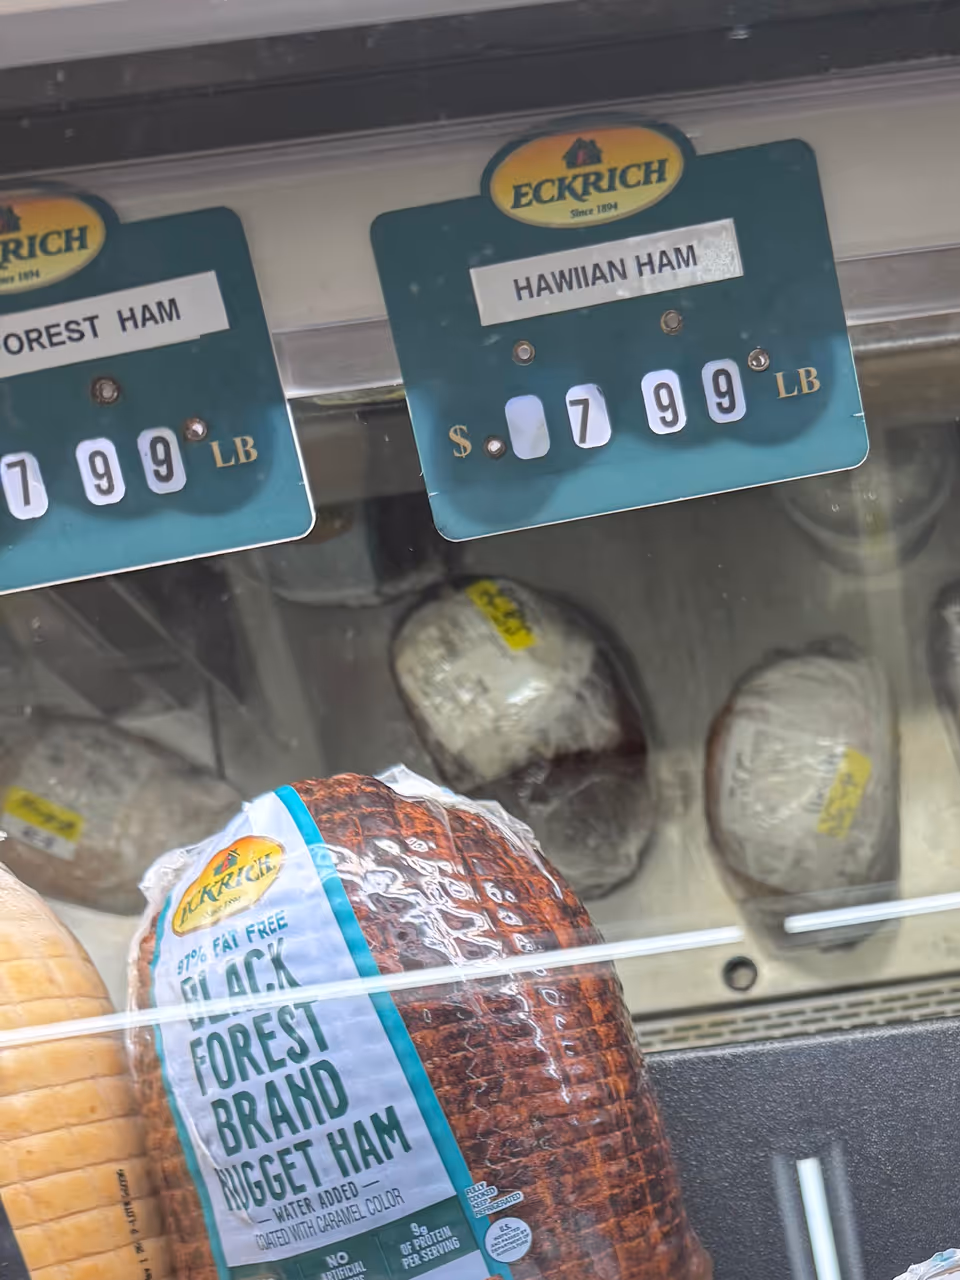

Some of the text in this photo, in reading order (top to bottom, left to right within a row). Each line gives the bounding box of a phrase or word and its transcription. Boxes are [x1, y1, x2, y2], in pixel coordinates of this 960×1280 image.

[510, 158, 668, 211] ECKRICH
[569, 201, 619, 219] Since 1894
[0, 225, 89, 270] RICH
[513, 244, 698, 301] HAWIIAN HAM
[0, 298, 182, 357] OREST HAM
[773, 366, 821, 399] LB
[210, 435, 259, 469] LB
[213, 929, 240, 958] FAT
[245, 910, 289, 943] FREE
[180, 937, 302, 1031] BLACK
[189, 999, 330, 1097] FOREST
[211, 1059, 350, 1157] BRAND
[214, 1105, 412, 1212] NUGGET HAM
[255, 1187, 406, 1251] COATED WITH CARAMEL COLOR
[272, 1181, 359, 1224] WATER ADDED
[326, 1251, 349, 1268] NO
[400, 1226, 452, 1256] OF PROTEIN
[402, 1236, 460, 1269] PER SERVING
